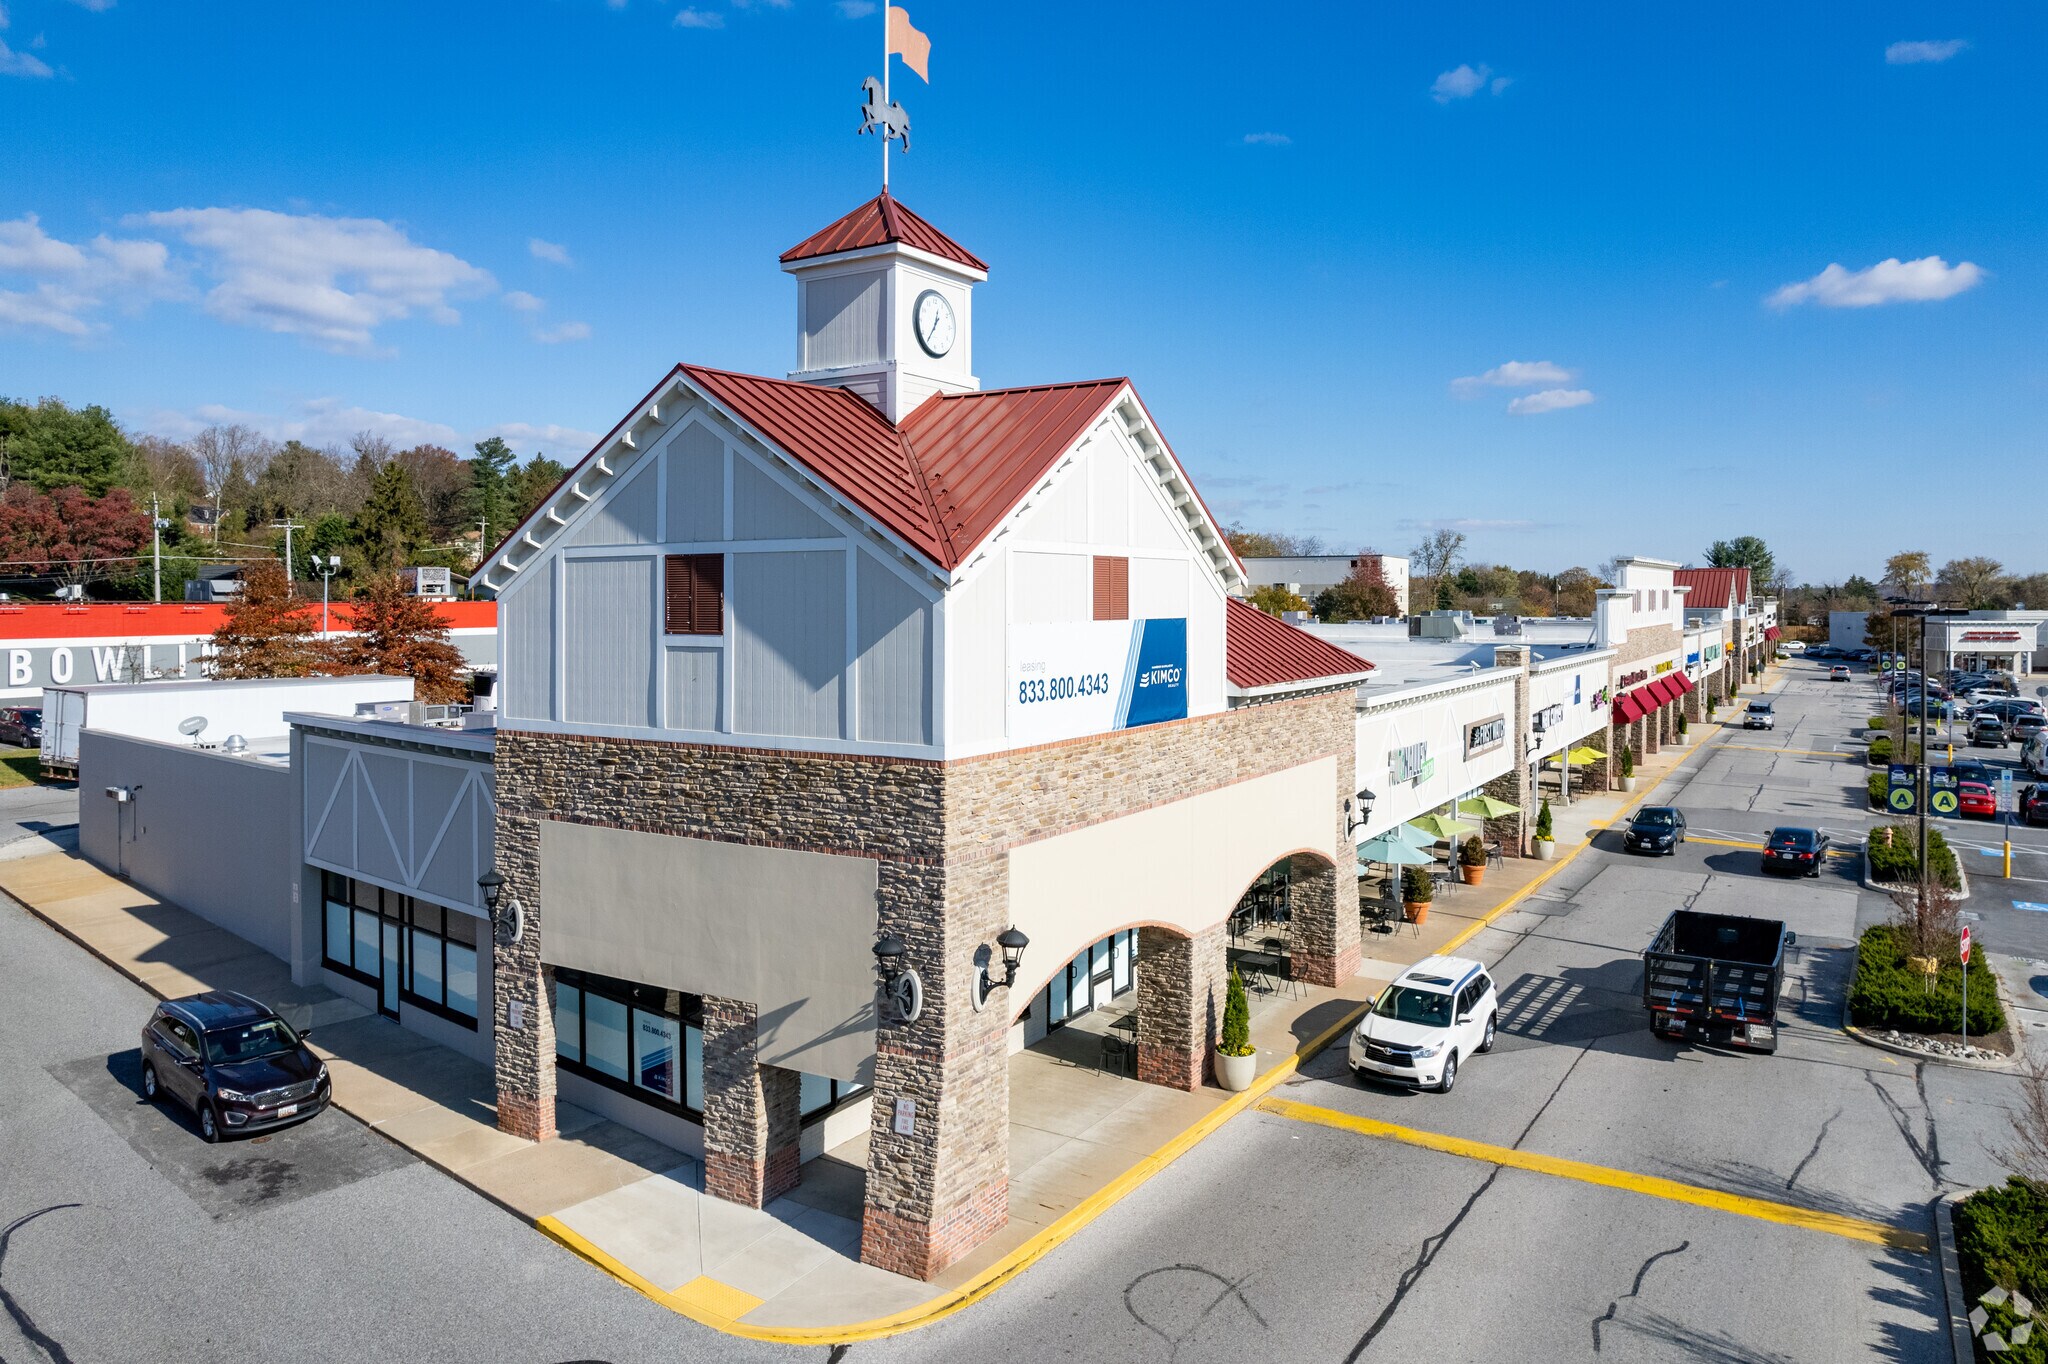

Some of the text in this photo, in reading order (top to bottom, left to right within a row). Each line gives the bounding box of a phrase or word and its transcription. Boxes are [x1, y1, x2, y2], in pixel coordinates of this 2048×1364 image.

[8, 644, 247, 686] BOWLIN
[1019, 660, 1046, 674] leasing
[1151, 668, 1180, 685] KIMCO
[1019, 673, 1108, 704] 833.800.4343
[1895, 793, 1909, 805] A
[1938, 795, 1952, 808] A
[897, 1109, 914, 1119] PARKING
